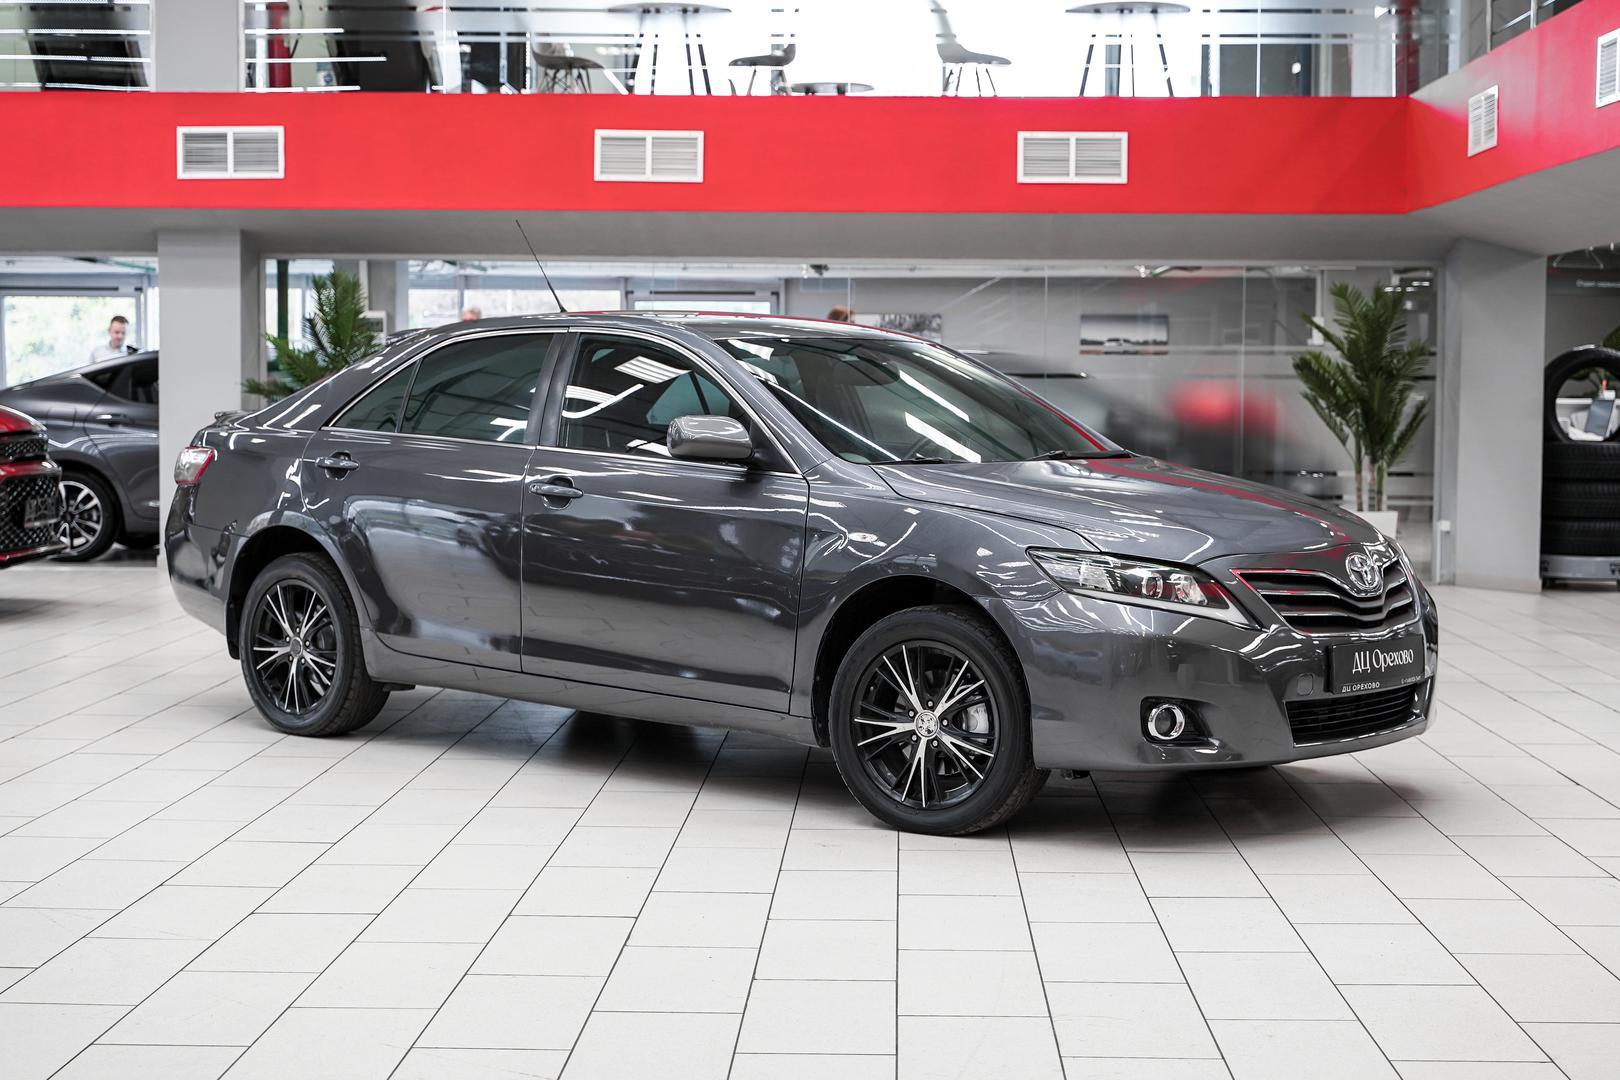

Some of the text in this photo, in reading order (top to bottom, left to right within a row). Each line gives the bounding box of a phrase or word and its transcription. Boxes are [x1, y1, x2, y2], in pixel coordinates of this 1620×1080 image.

[1352, 649, 1414, 674] ДЦ Орехово
[1352, 681, 1380, 691] ОРЕХОВО
